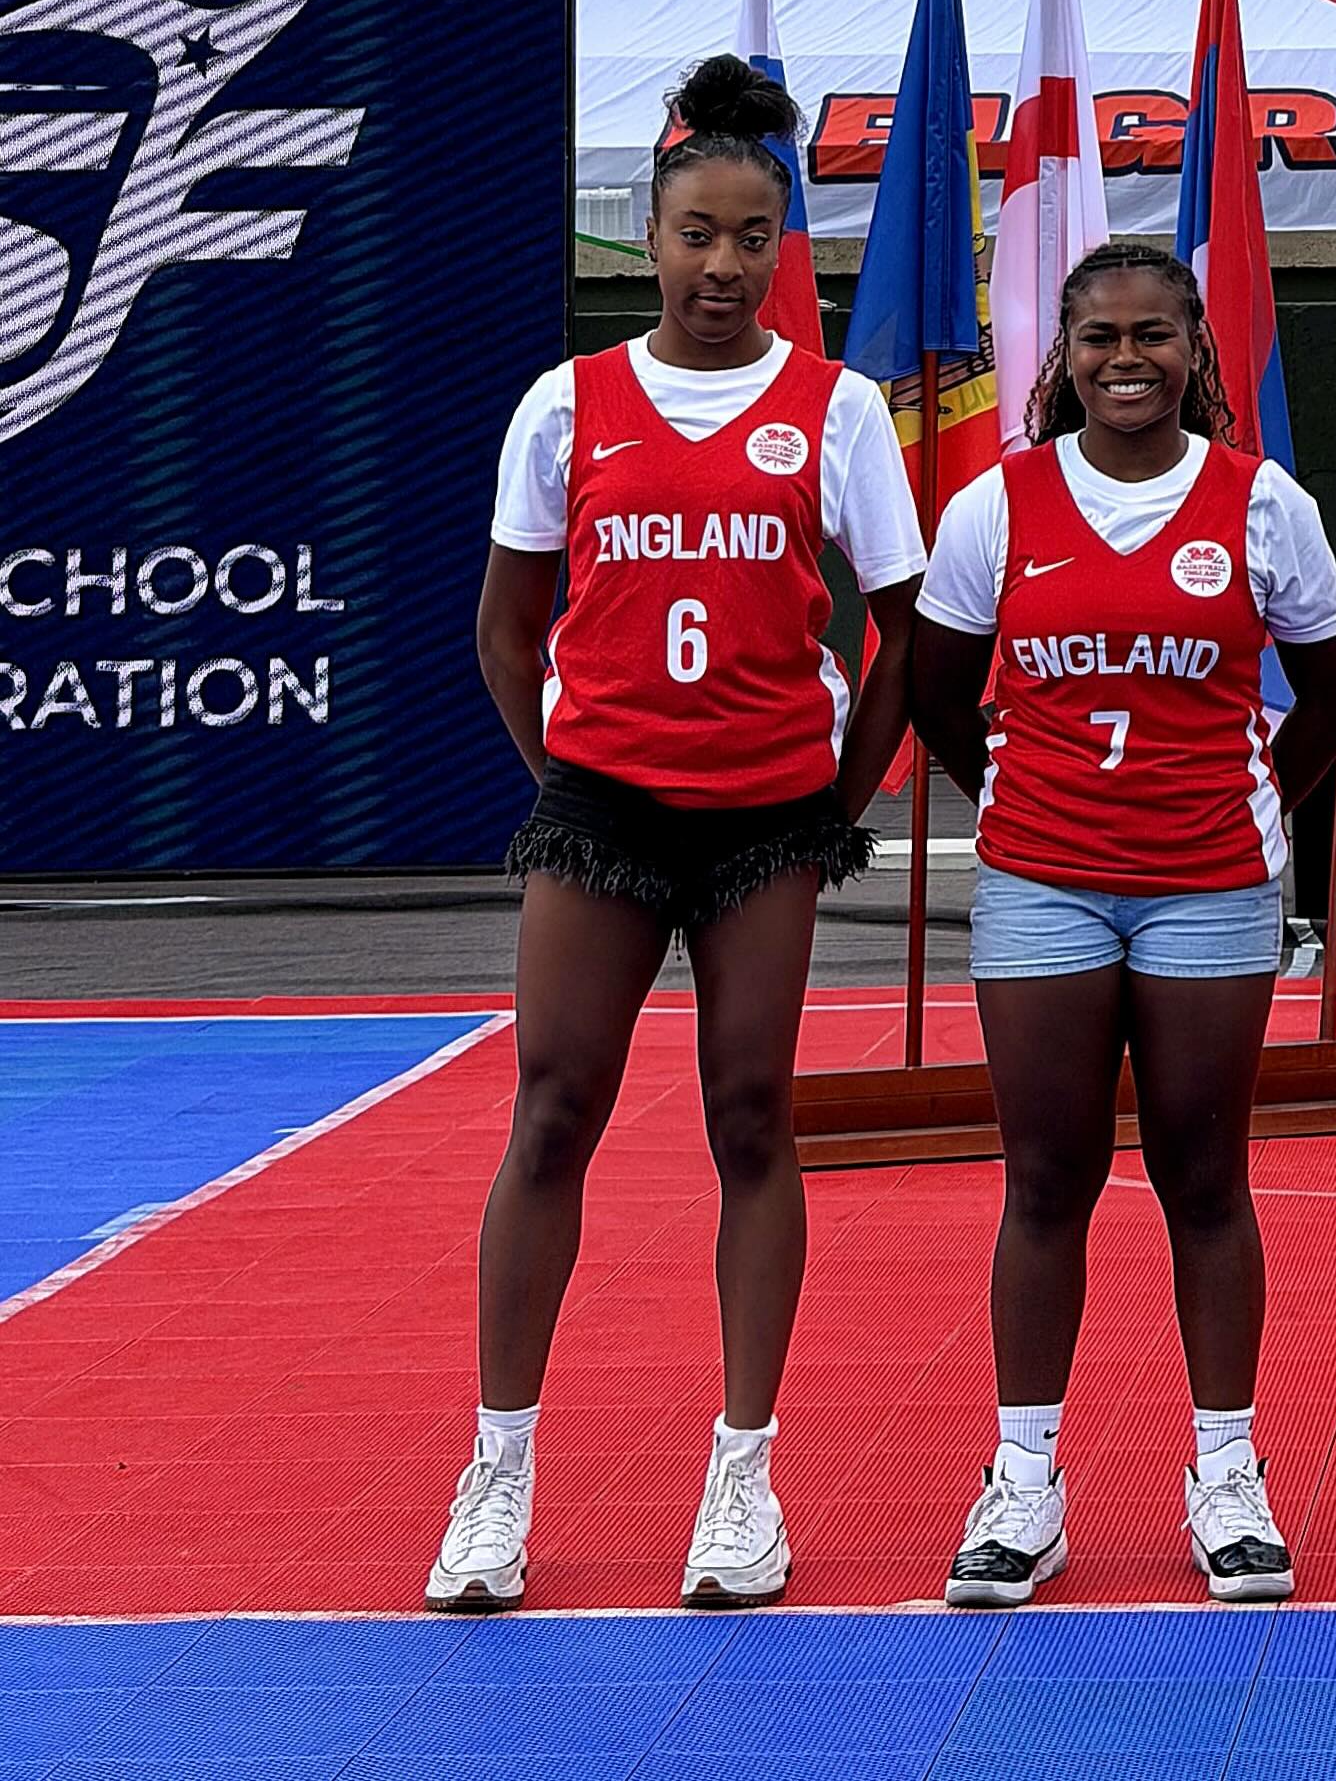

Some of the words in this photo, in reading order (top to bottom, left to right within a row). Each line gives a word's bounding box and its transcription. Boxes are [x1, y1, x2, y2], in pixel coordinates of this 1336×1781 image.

[594, 513, 786, 563] ENGLAND
[0, 544, 345, 617] CHOOL
[667, 597, 708, 683] 6
[1012, 633, 1220, 680] ENGLAND
[1089, 710, 1130, 770] 7
